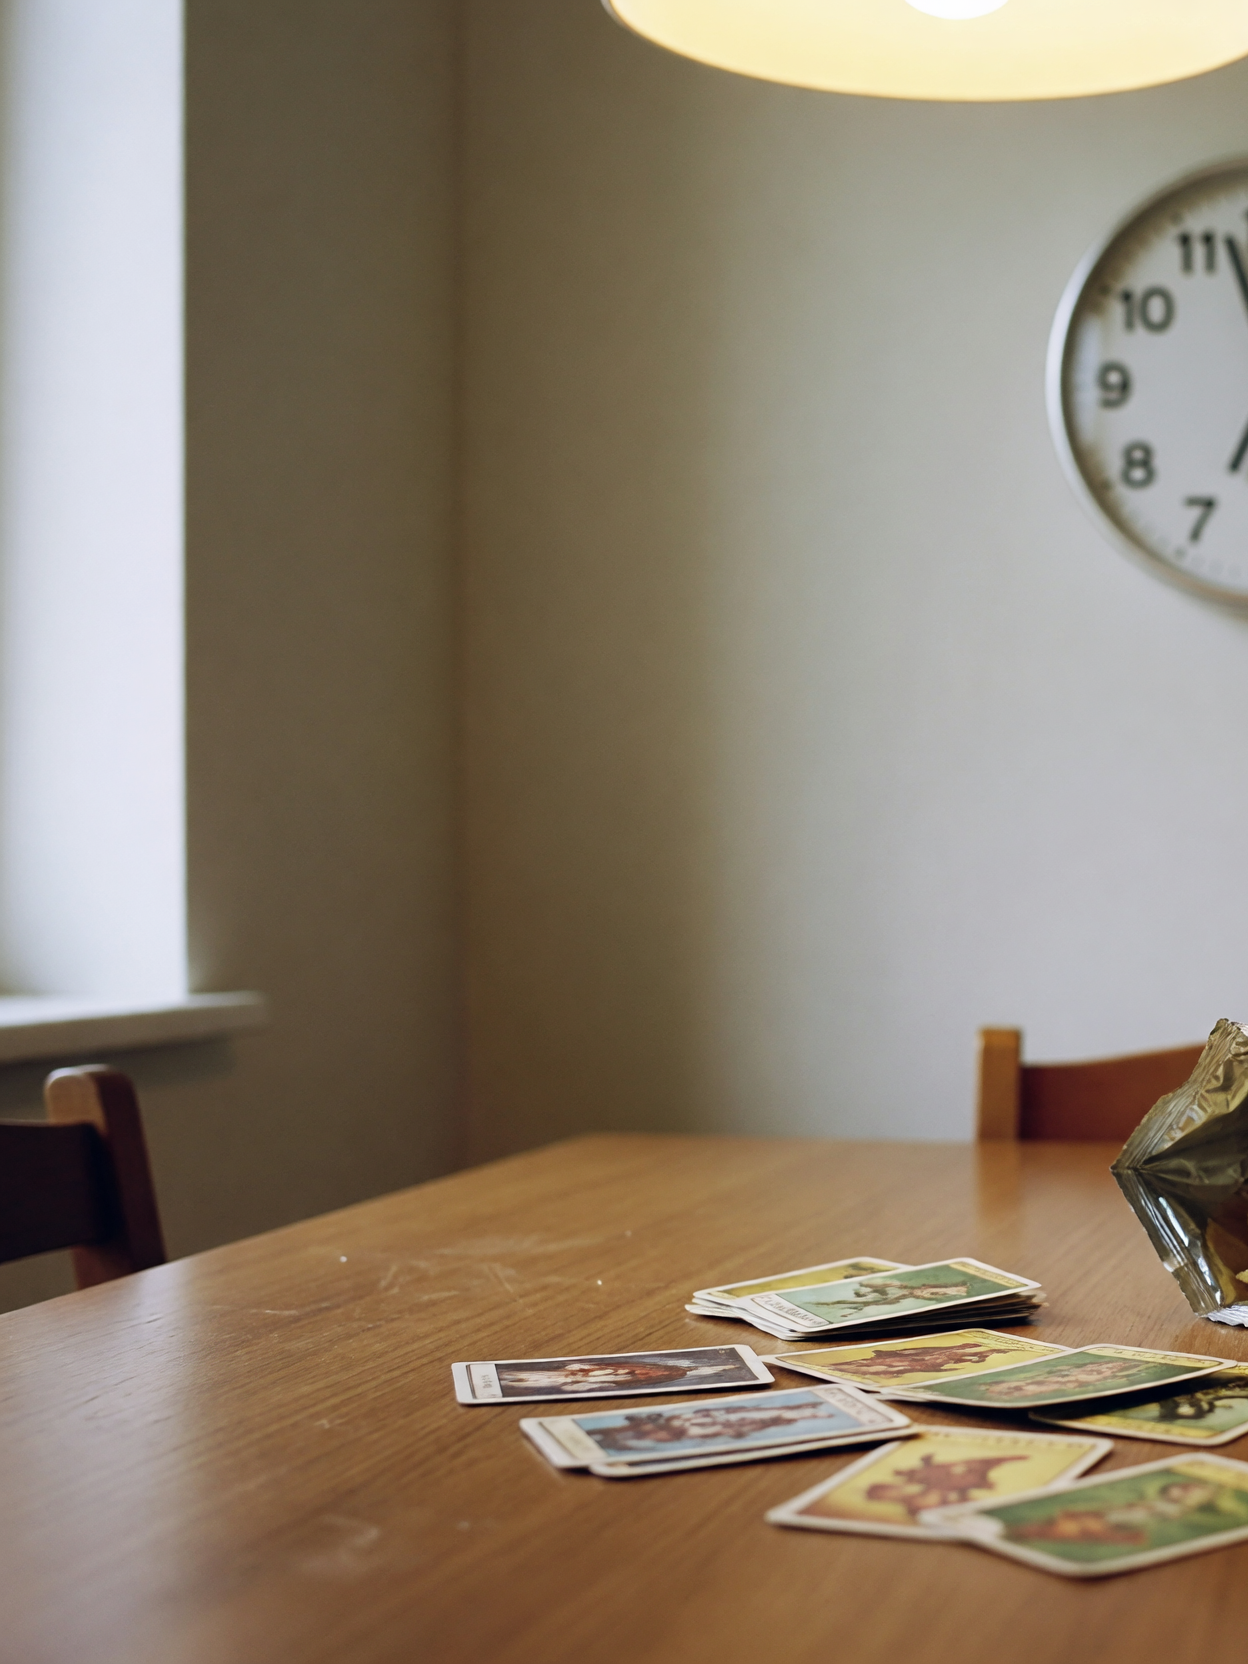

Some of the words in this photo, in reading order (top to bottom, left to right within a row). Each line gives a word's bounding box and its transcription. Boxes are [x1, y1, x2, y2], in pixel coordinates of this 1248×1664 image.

[1175, 229, 1216, 274] 11
[1120, 286, 1175, 333] 10
[1098, 361, 1132, 409] 9
[1120, 441, 1156, 489] 8
[1184, 496, 1218, 543] 7
